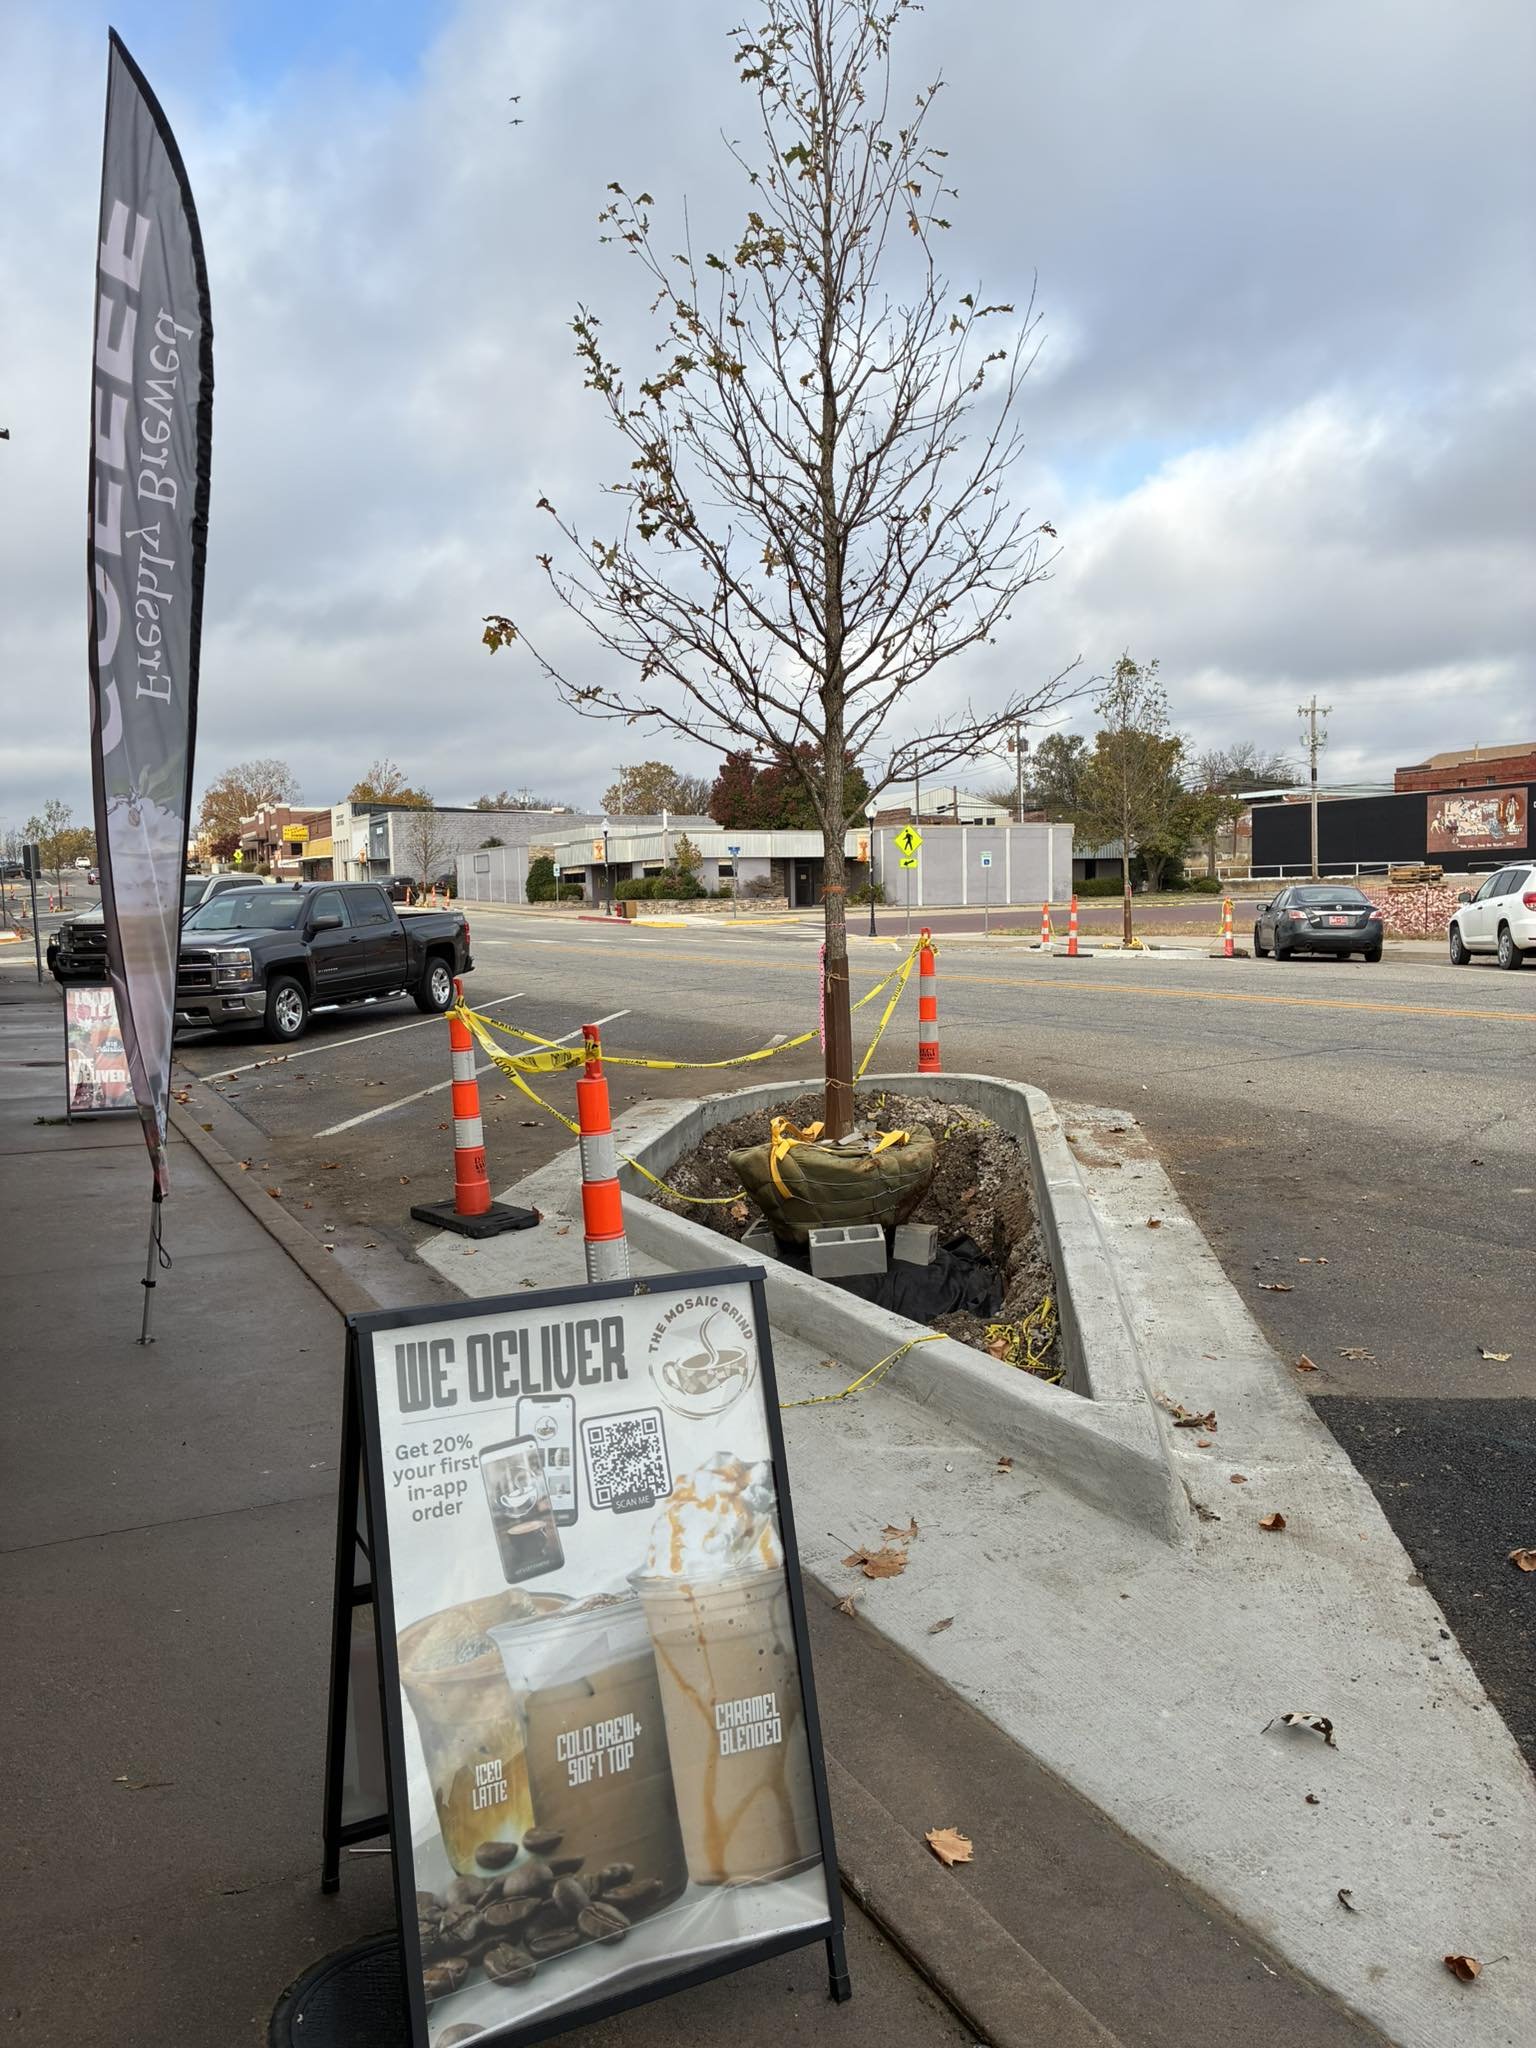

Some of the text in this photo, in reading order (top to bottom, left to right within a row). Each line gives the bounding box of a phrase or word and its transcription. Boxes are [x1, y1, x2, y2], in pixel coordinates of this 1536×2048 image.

[648, 1296, 753, 1353] THE MOSAIC GRIND
[395, 1315, 629, 1413] WE DELIVER
[395, 1433, 473, 1460] Get 20%
[392, 1454, 479, 1487] your first
[408, 1480, 468, 1501] in-app
[616, 1495, 651, 1509] SCAN ME
[412, 1501, 463, 1522] order
[715, 1692, 780, 1730] CARAMEL
[557, 1725, 592, 1762] COLD
[719, 1717, 782, 1756] BLENDED
[475, 1759, 502, 1786] ICED
[568, 1742, 634, 1787] SOFT TOP
[472, 1780, 508, 1811] LATTE
